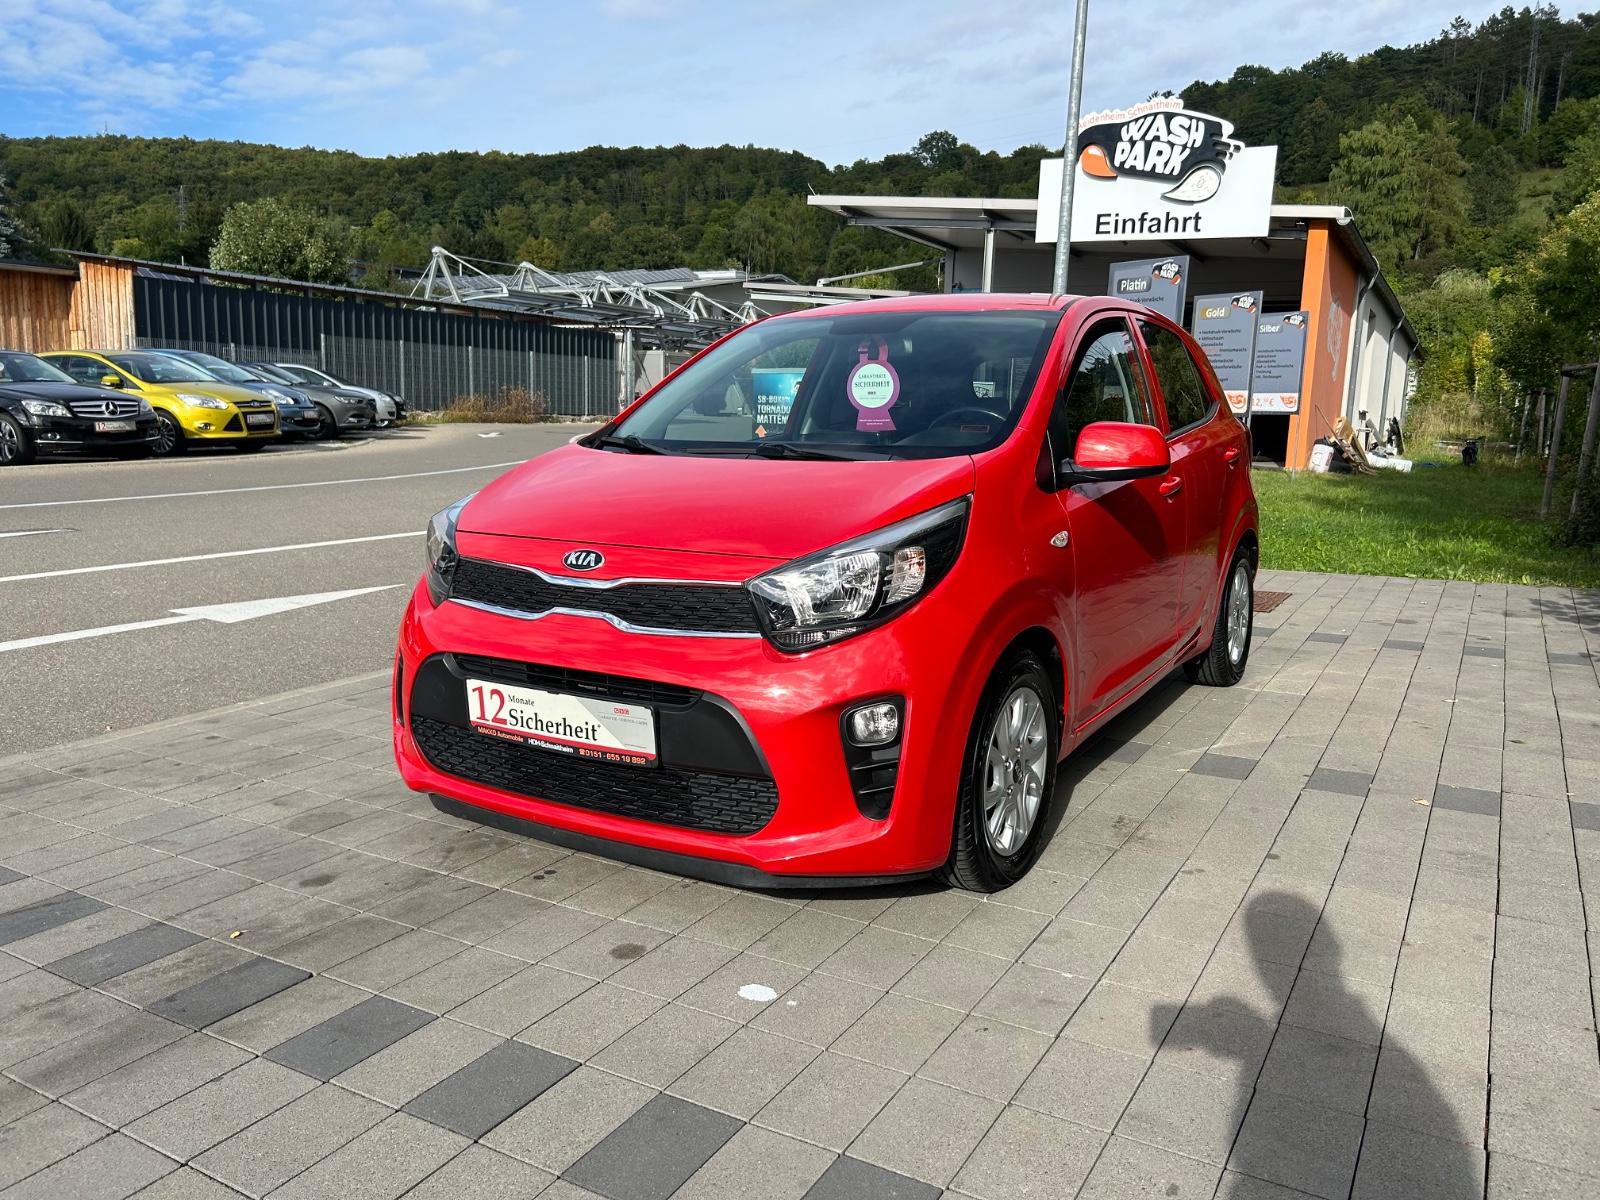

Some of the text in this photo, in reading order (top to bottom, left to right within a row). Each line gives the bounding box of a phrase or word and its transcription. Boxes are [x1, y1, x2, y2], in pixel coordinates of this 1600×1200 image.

[1127, 101, 1181, 119] Schnaitheim
[1121, 114, 1205, 148] WASH
[1114, 141, 1190, 176] PARK
[1095, 211, 1202, 235] Einfahrt
[1120, 278, 1147, 292] Platin
[1205, 307, 1225, 318] Gold
[1259, 324, 1281, 333] Silber
[566, 551, 597, 567] KIA
[472, 685, 508, 726] 12
[508, 694, 535, 707] Monate
